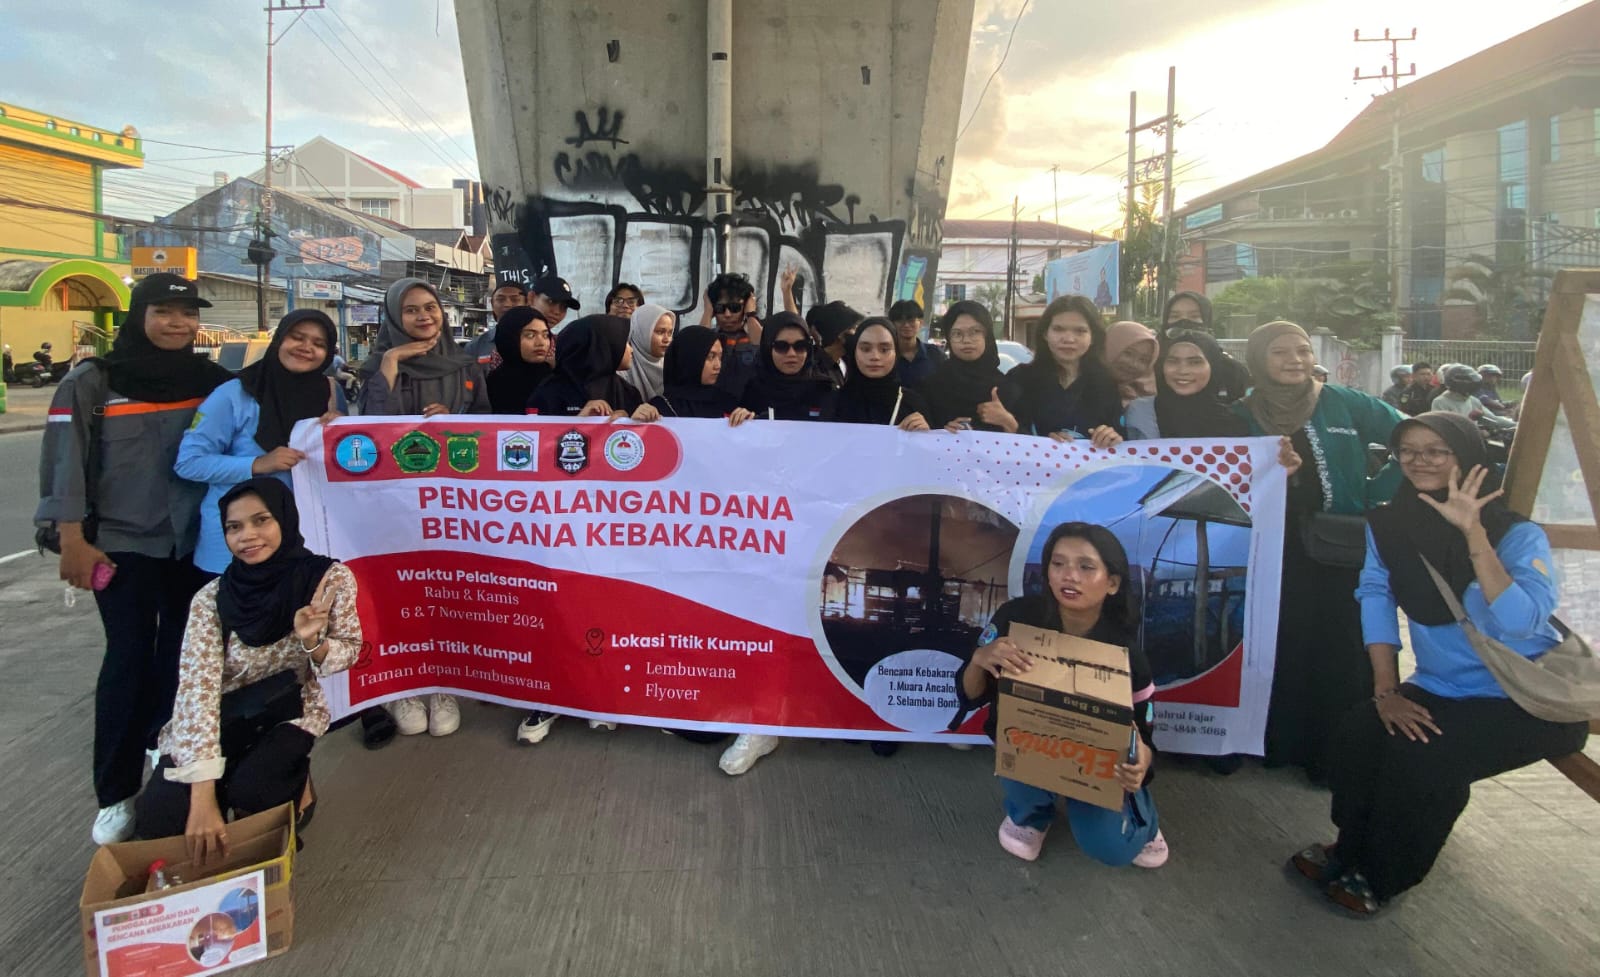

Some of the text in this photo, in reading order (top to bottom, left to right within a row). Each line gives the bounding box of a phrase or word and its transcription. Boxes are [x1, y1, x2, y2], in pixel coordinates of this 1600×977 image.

[500, 268, 530, 284] THIS
[418, 486, 794, 521] PENGGALANGAN DANA
[422, 517, 786, 555] BENCANA KEBAKARAN
[397, 568, 558, 592] Waktu Pelaksanaan
[424, 586, 520, 606] Rabu & Kamis
[400, 605, 545, 630] 6 & 7 November 2024
[379, 639, 532, 665] Lokasi Titik Kumpul
[611, 633, 773, 656] Lokasi Titik Kumpul
[357, 661, 551, 691] Taman depan Lembuswana
[646, 661, 737, 679] Lembuwana
[878, 665, 913, 677] Bencana
[645, 683, 701, 702] Flyover
[897, 682, 923, 692] Muara
[897, 695, 935, 708] Selambai
[1153, 710, 1215, 724] yahrul Fajar
[1005, 728, 1119, 779] Ekomie
